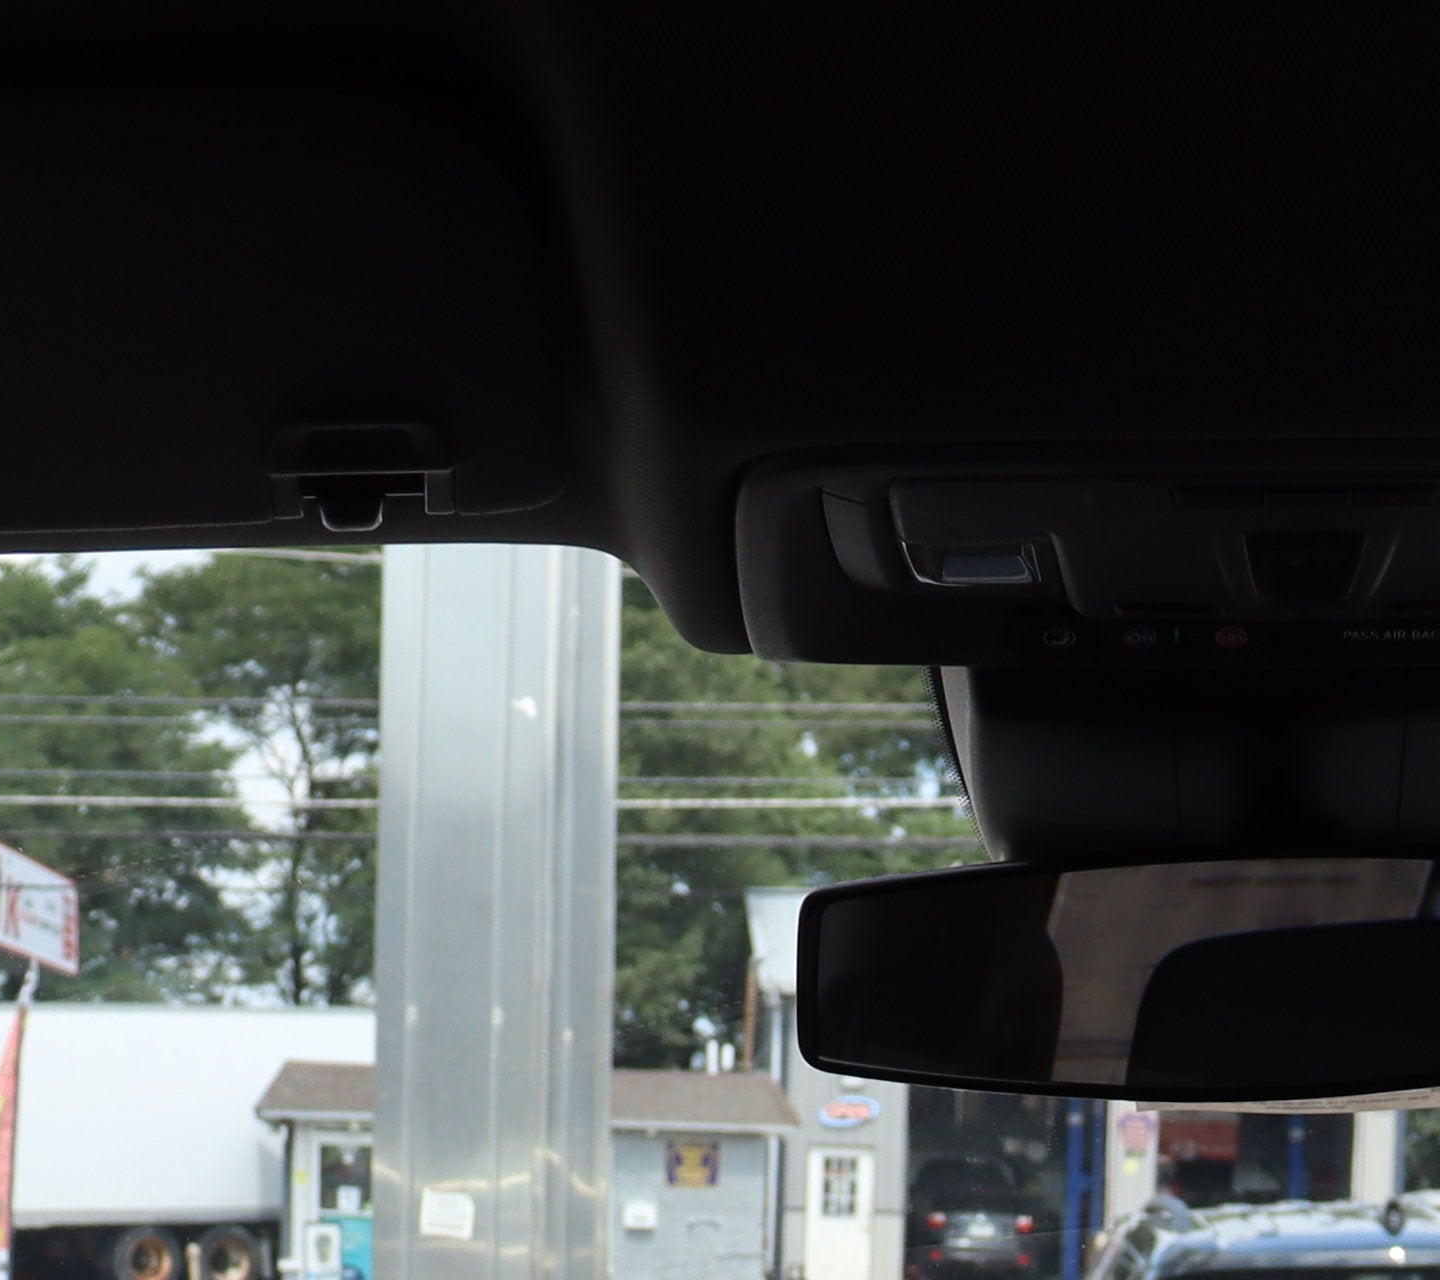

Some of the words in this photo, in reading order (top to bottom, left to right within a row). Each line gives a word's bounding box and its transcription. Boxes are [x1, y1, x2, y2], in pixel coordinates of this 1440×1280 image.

[1343, 629, 1379, 641] PASS
[1383, 629, 1406, 641] AIR
[1410, 629, 1440, 641] BAG
